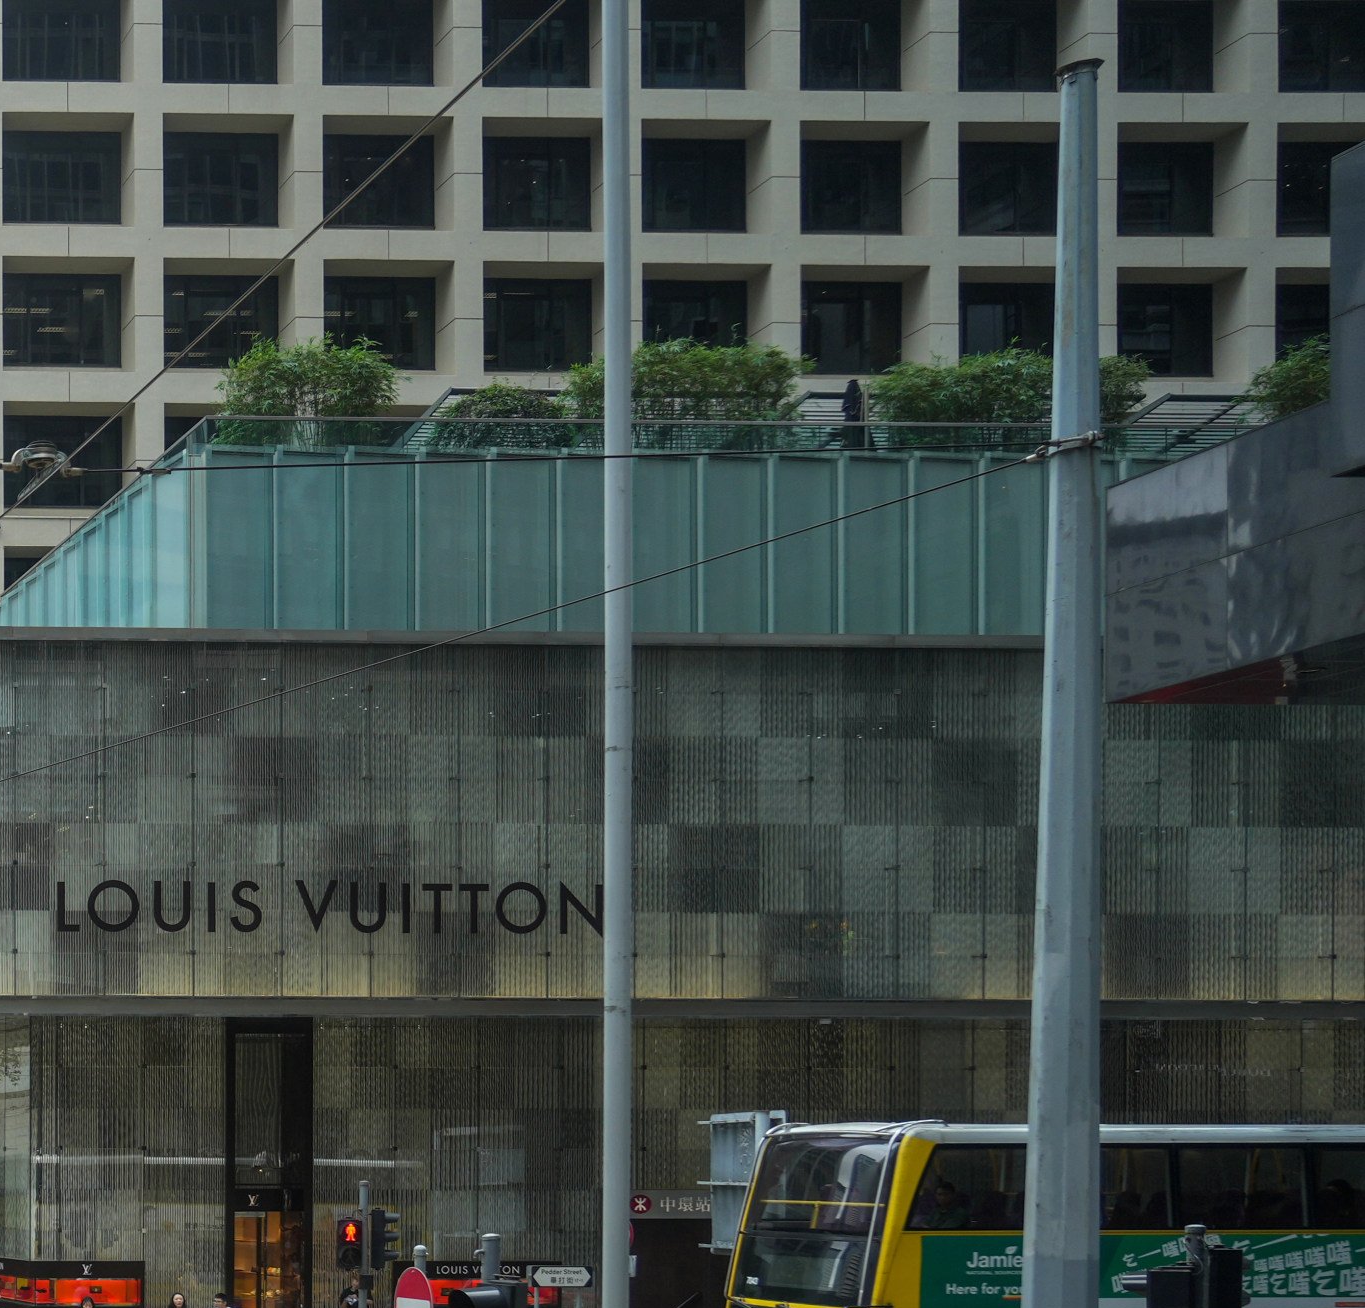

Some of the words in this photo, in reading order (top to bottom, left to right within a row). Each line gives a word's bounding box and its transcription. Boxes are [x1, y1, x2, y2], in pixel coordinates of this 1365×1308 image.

[57, 880, 262, 933] LOUIS
[295, 879, 604, 936] VUITTON
[660, 1195, 711, 1213] 中環站
[436, 1265, 469, 1275] LOUIS
[541, 1268, 563, 1276] Pedder
[563, 1268, 583, 1276] Street
[946, 1283, 978, 1295] Here
[981, 1283, 1001, 1295] for
